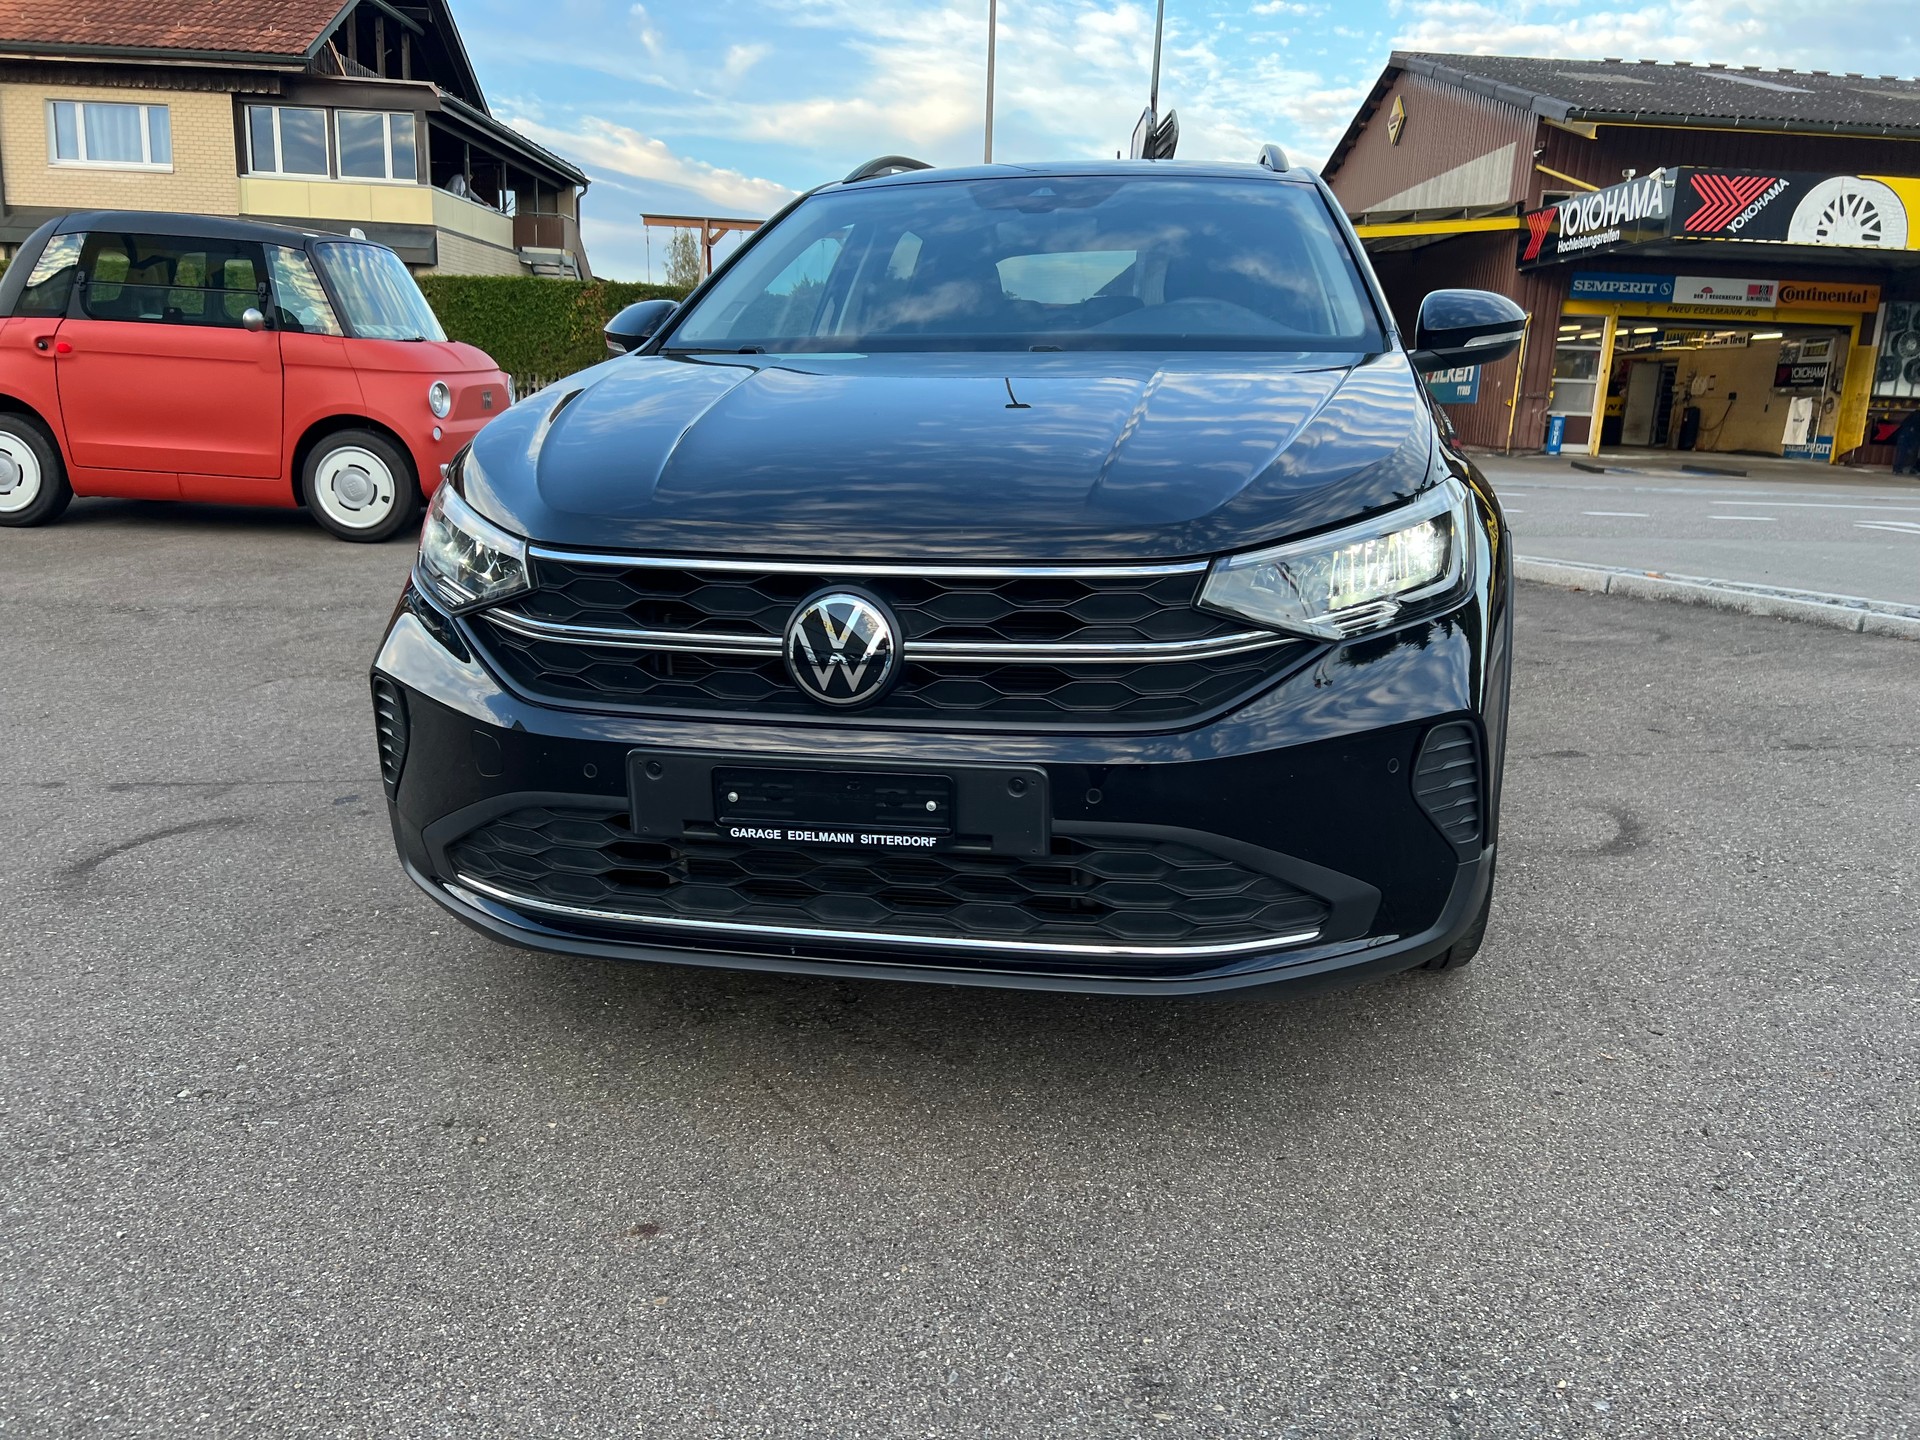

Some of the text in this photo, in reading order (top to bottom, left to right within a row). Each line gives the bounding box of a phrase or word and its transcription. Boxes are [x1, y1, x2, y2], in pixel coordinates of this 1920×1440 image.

[1558, 180, 1663, 238] YOKOHAMA
[1727, 178, 1790, 234] YOKOHAMA
[1557, 229, 1620, 254] Hochleistungsreifen
[1573, 280, 1657, 294] SEMPERIT
[1778, 286, 1868, 304] Continental
[1667, 306, 1691, 314] PNEU
[1693, 306, 1743, 315] EDELMANN
[730, 827, 937, 847] GARAGE EDELMANN SITTERDORF
